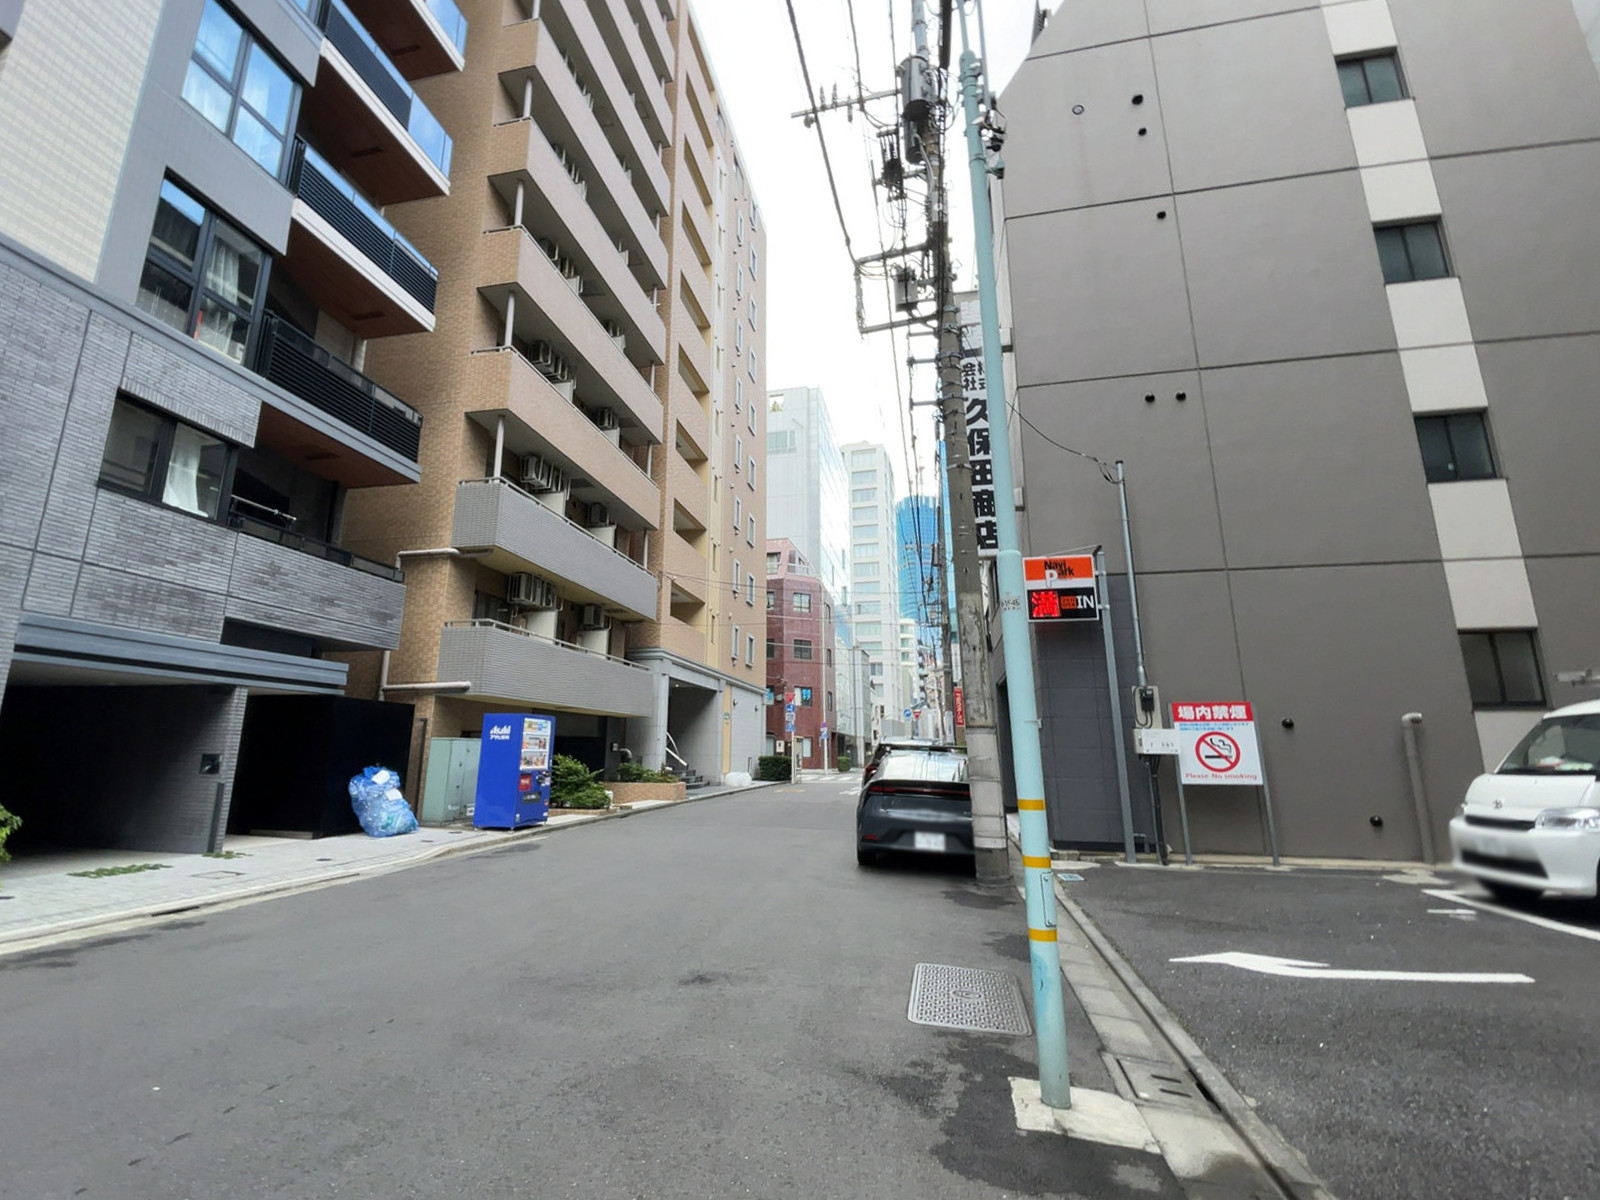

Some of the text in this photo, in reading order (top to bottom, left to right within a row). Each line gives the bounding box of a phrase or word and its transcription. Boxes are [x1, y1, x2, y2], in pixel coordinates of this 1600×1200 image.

[966, 398, 998, 549] 久保田商店
[1044, 560, 1066, 571] Navi
[1076, 595, 1095, 609] IN
[1178, 705, 1247, 719] 場内禁煙
